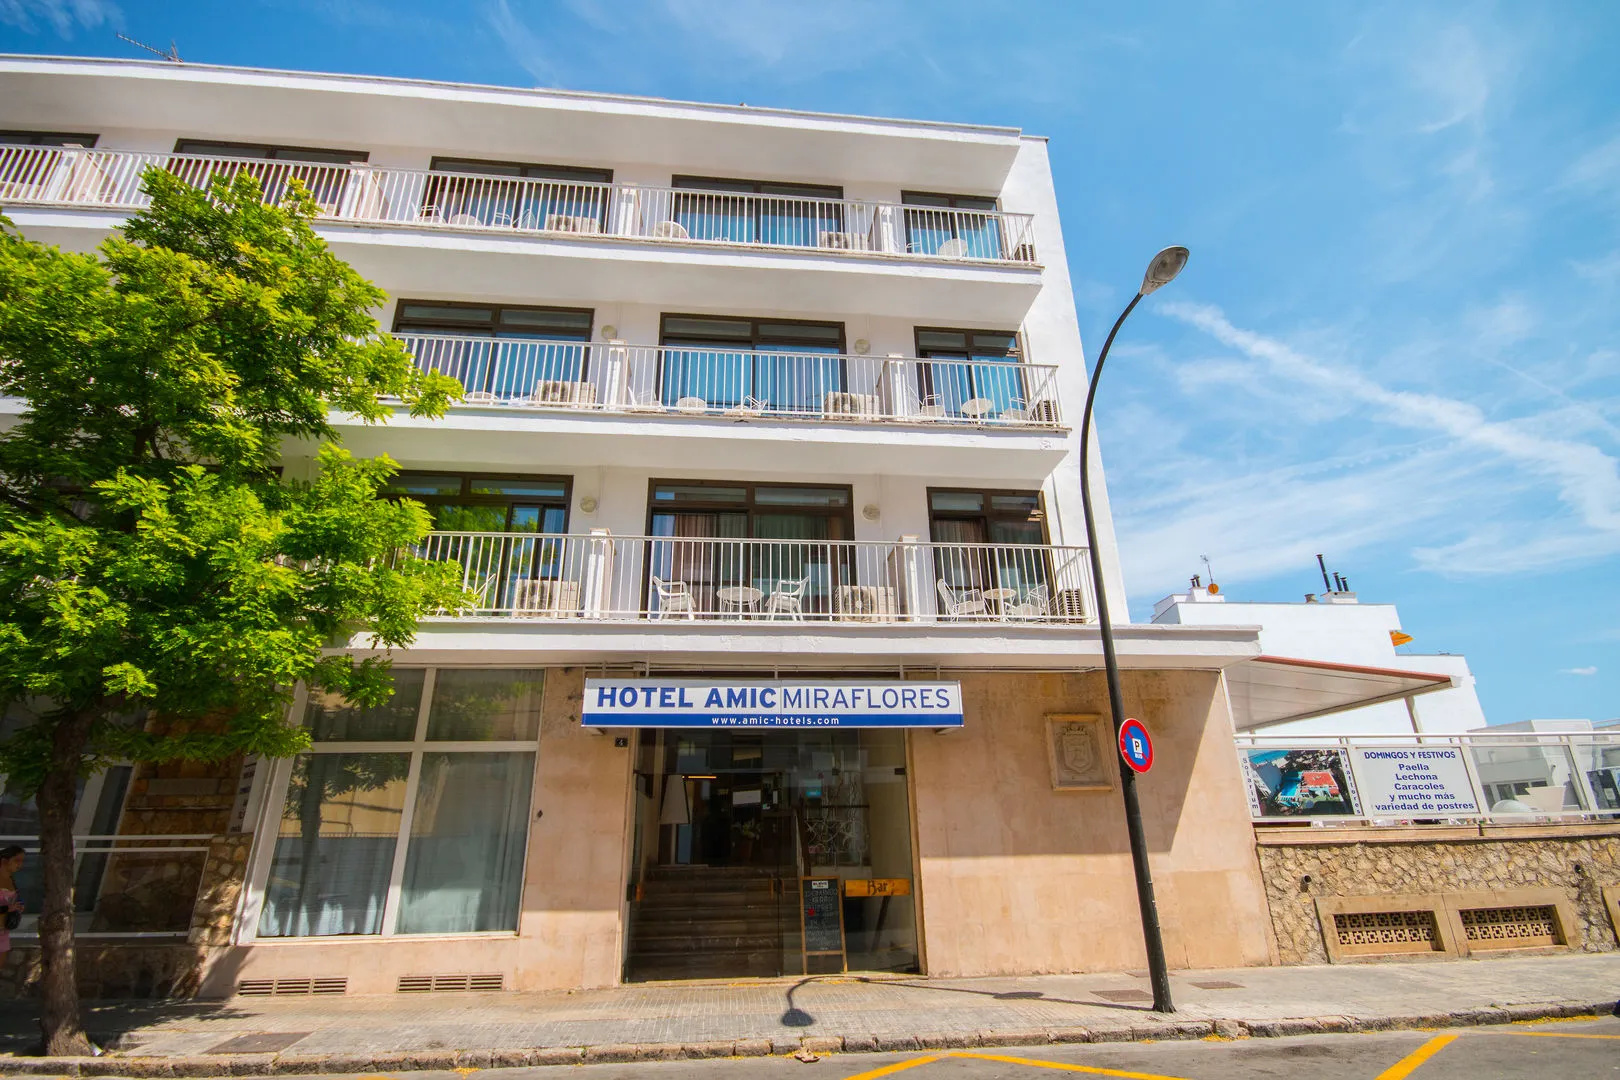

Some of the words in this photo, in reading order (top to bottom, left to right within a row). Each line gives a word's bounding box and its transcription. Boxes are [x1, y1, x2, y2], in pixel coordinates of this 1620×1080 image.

[597, 686, 694, 708] HOTEL
[704, 687, 776, 709] AMIC
[783, 688, 950, 709] MIRAFLORES
[711, 715, 840, 725] www.amic-hotels.com
[1364, 751, 1409, 759] DOMINGOS
[1409, 751, 1416, 759] Y
[1418, 751, 1456, 759] FESTIVOS
[1398, 763, 1430, 771] Paella
[1395, 773, 1438, 781] Lechona
[1242, 758, 1259, 809] Solarium
[1394, 783, 1445, 791] Caracoles
[1389, 794, 1395, 802] y
[1398, 792, 1432, 800] mucho
[1434, 792, 1456, 800] más
[1375, 803, 1419, 811] variedad
[1437, 802, 1475, 812] postres
